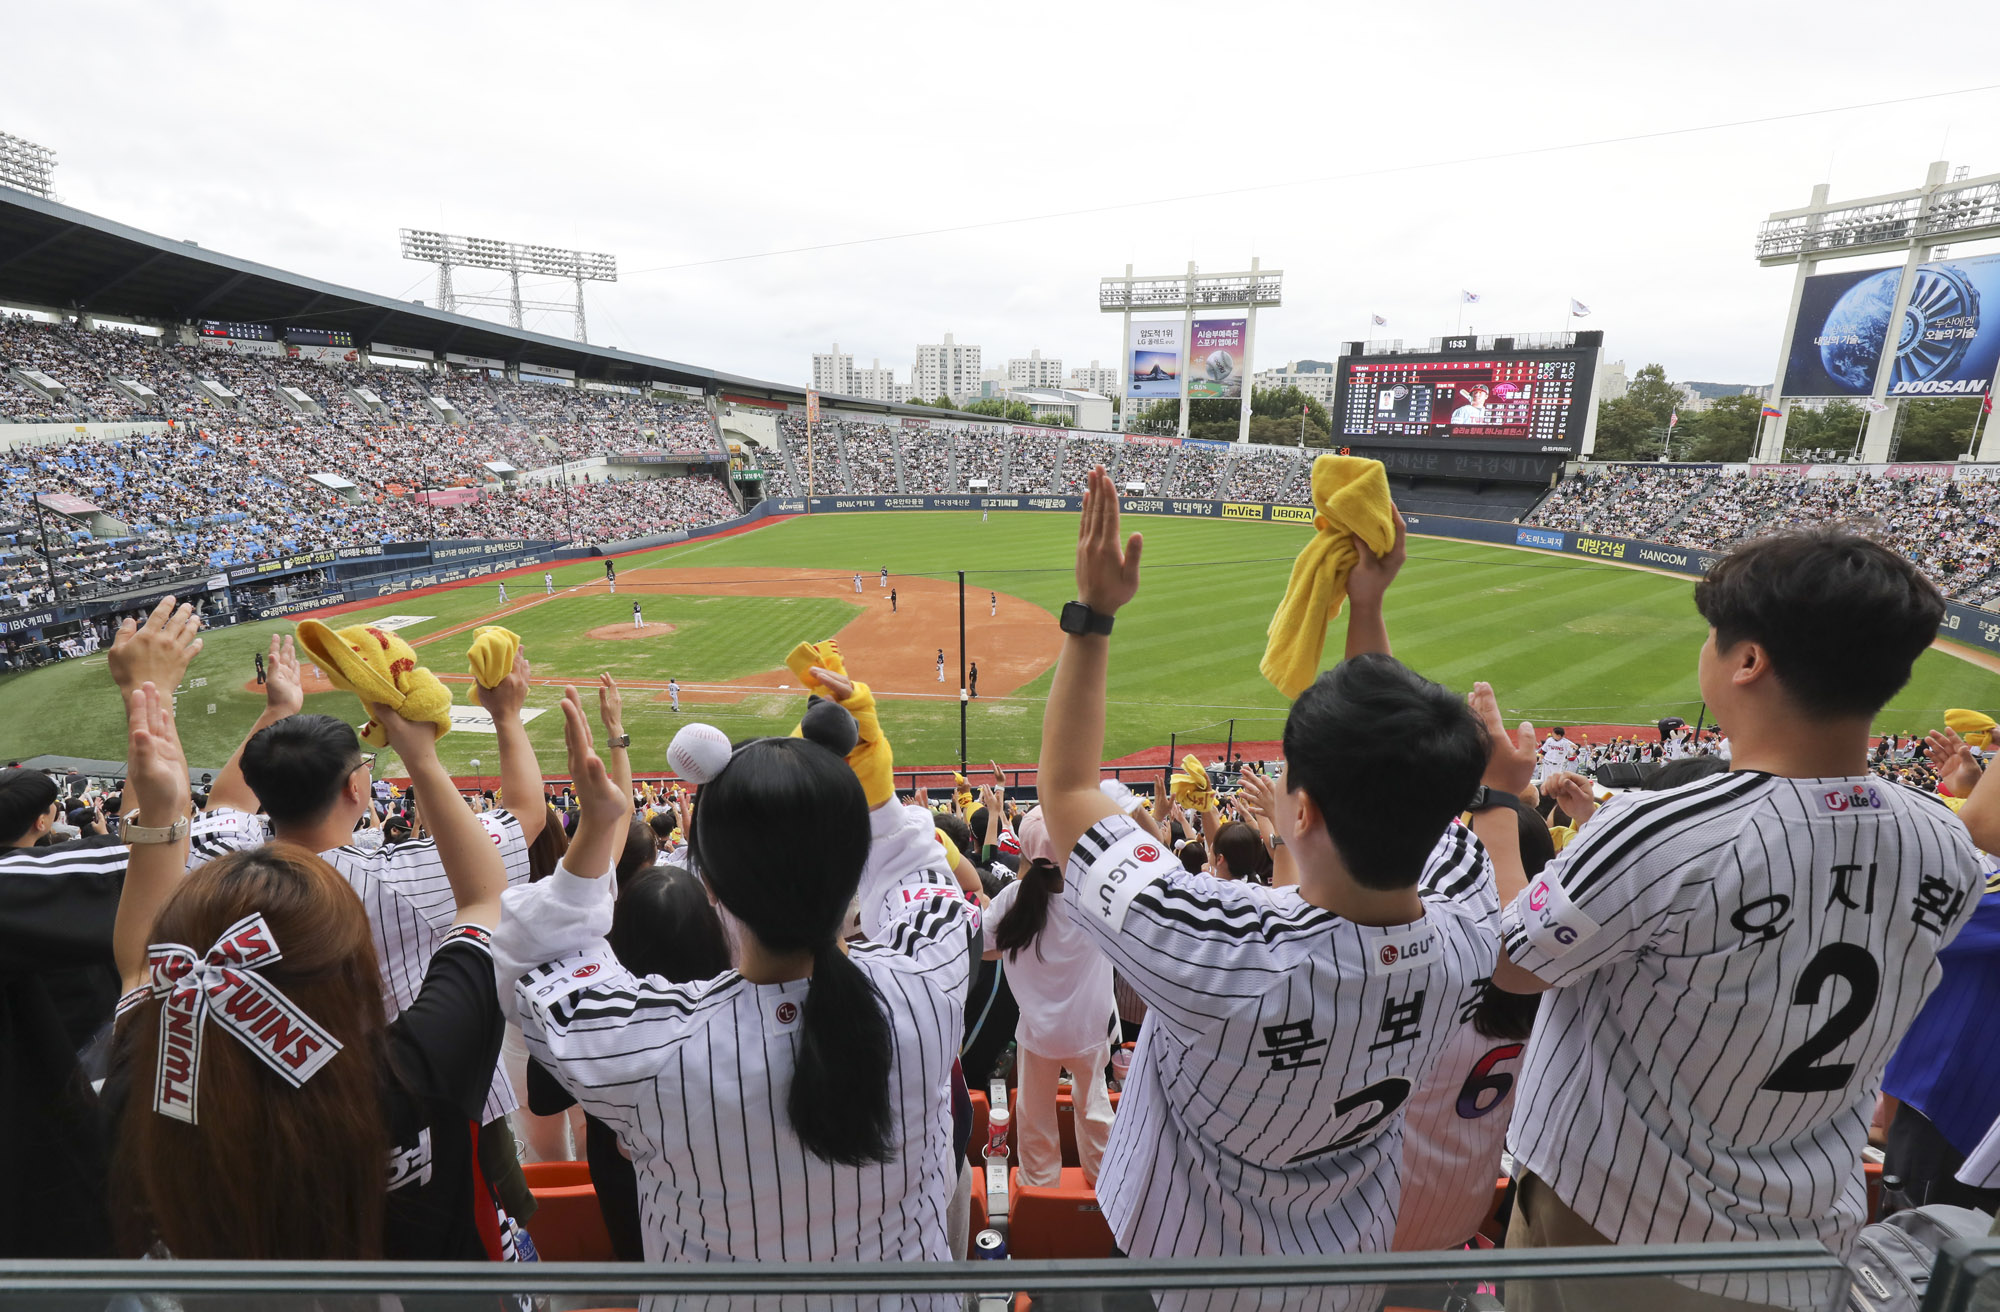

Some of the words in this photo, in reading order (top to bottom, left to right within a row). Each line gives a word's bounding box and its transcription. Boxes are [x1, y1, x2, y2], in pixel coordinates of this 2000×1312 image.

[1934, 316, 1975, 328] 두산에겐
[1140, 329, 1161, 339] 압도적
[1162, 329, 1174, 338] 1위
[1197, 329, 1239, 339] AI승부예측은
[1814, 334, 1840, 346] 내일의
[1924, 327, 1954, 341] 오늘의
[1954, 326, 1978, 339] 기술.
[1147, 338, 1165, 346] 올레드
[1218, 338, 1239, 347] 앱에서
[1448, 339, 1467, 349] 15:53
[1892, 379, 1988, 394] DOOSAN
[1137, 500, 1164, 513] 금강주택
[1172, 501, 1213, 515] 현대해상
[1272, 508, 1312, 520] UBORA
[1525, 534, 1563, 548] 도미노피자
[1576, 537, 1626, 559] 대방건설
[433, 549, 457, 559] 공공기관
[483, 540, 524, 554] 충남혁신도시
[1639, 548, 1688, 567] HANCOM
[230, 566, 256, 578] mentos
[207, 968, 323, 1070] TWINS
[1759, 942, 1881, 1094] 2
[163, 984, 199, 1105] TWINS
[1455, 1042, 1526, 1120] 6
